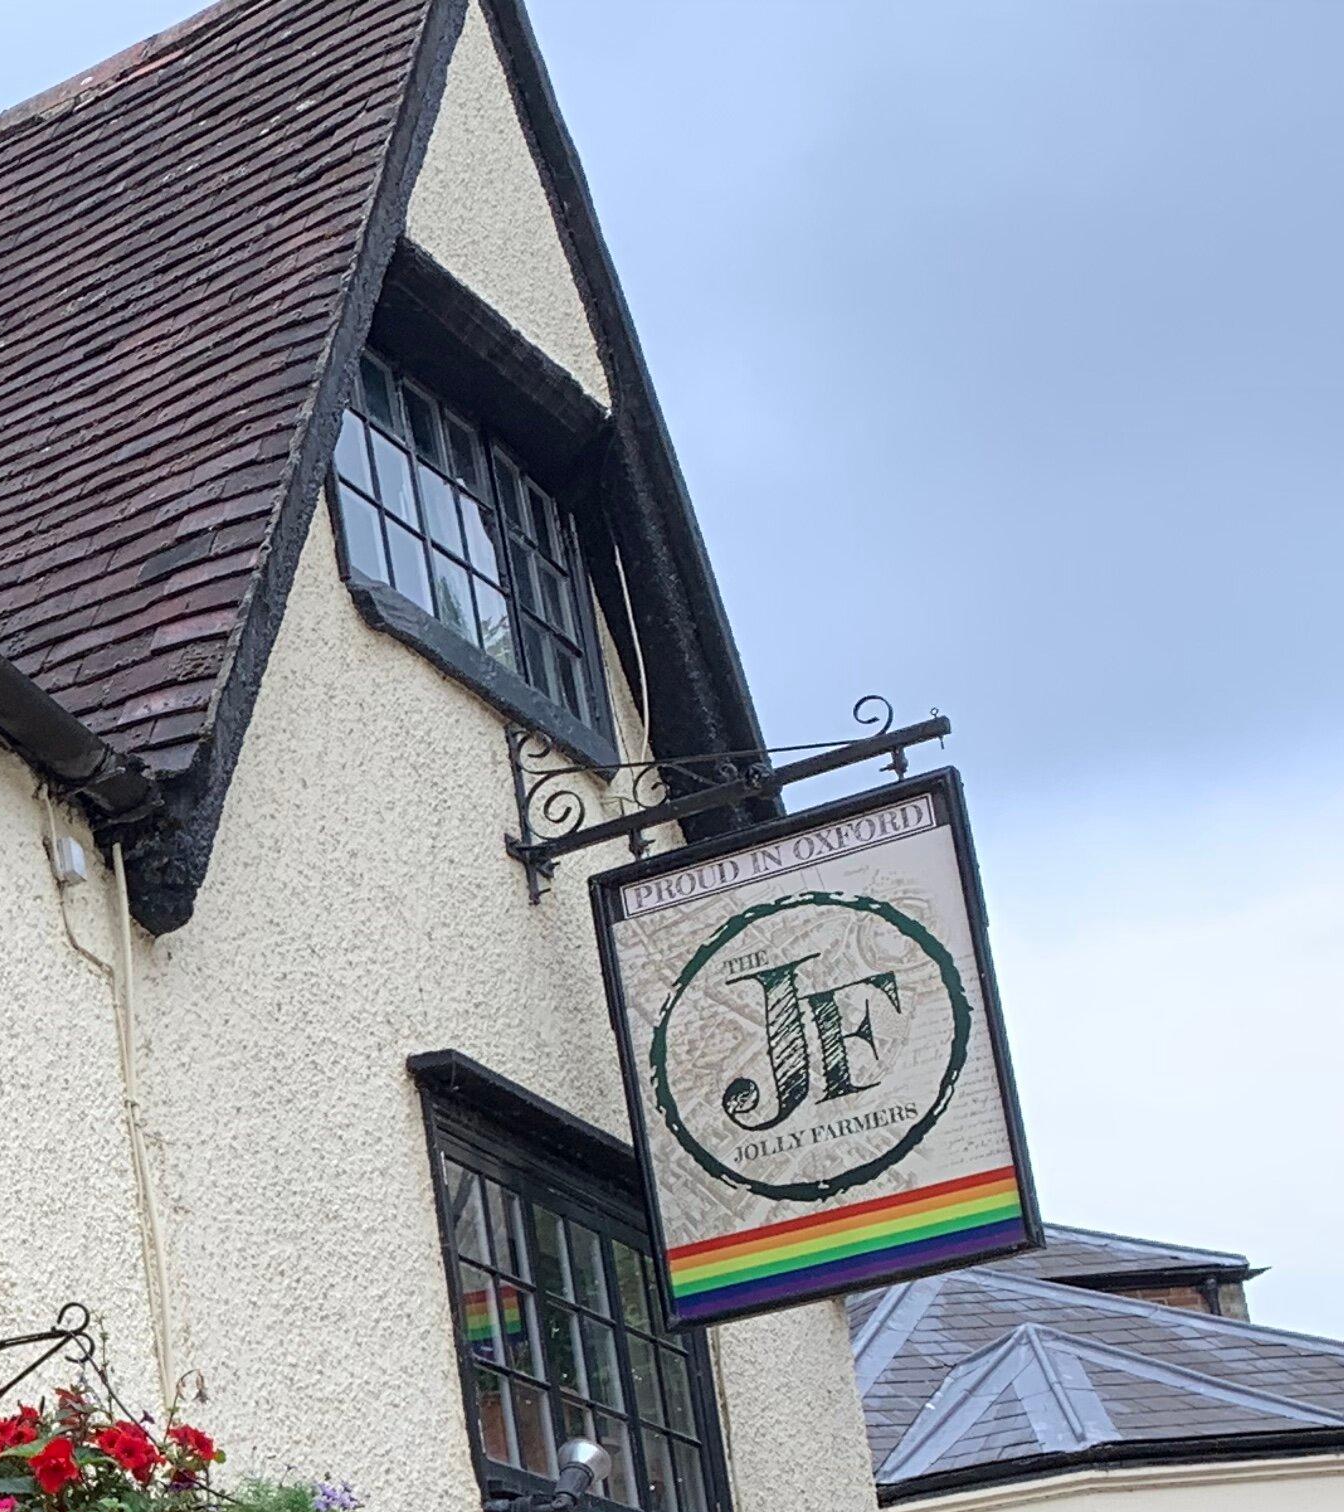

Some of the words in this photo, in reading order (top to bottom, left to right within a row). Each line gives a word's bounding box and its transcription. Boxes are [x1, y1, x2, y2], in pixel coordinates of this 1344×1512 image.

[632, 859, 740, 911] PROUD
[750, 845, 783, 876] IN
[792, 803, 924, 862] OXFORD
[723, 950, 769, 975] THE
[733, 1128, 806, 1163] JOLLY
[811, 1101, 919, 1144] FARMERS
